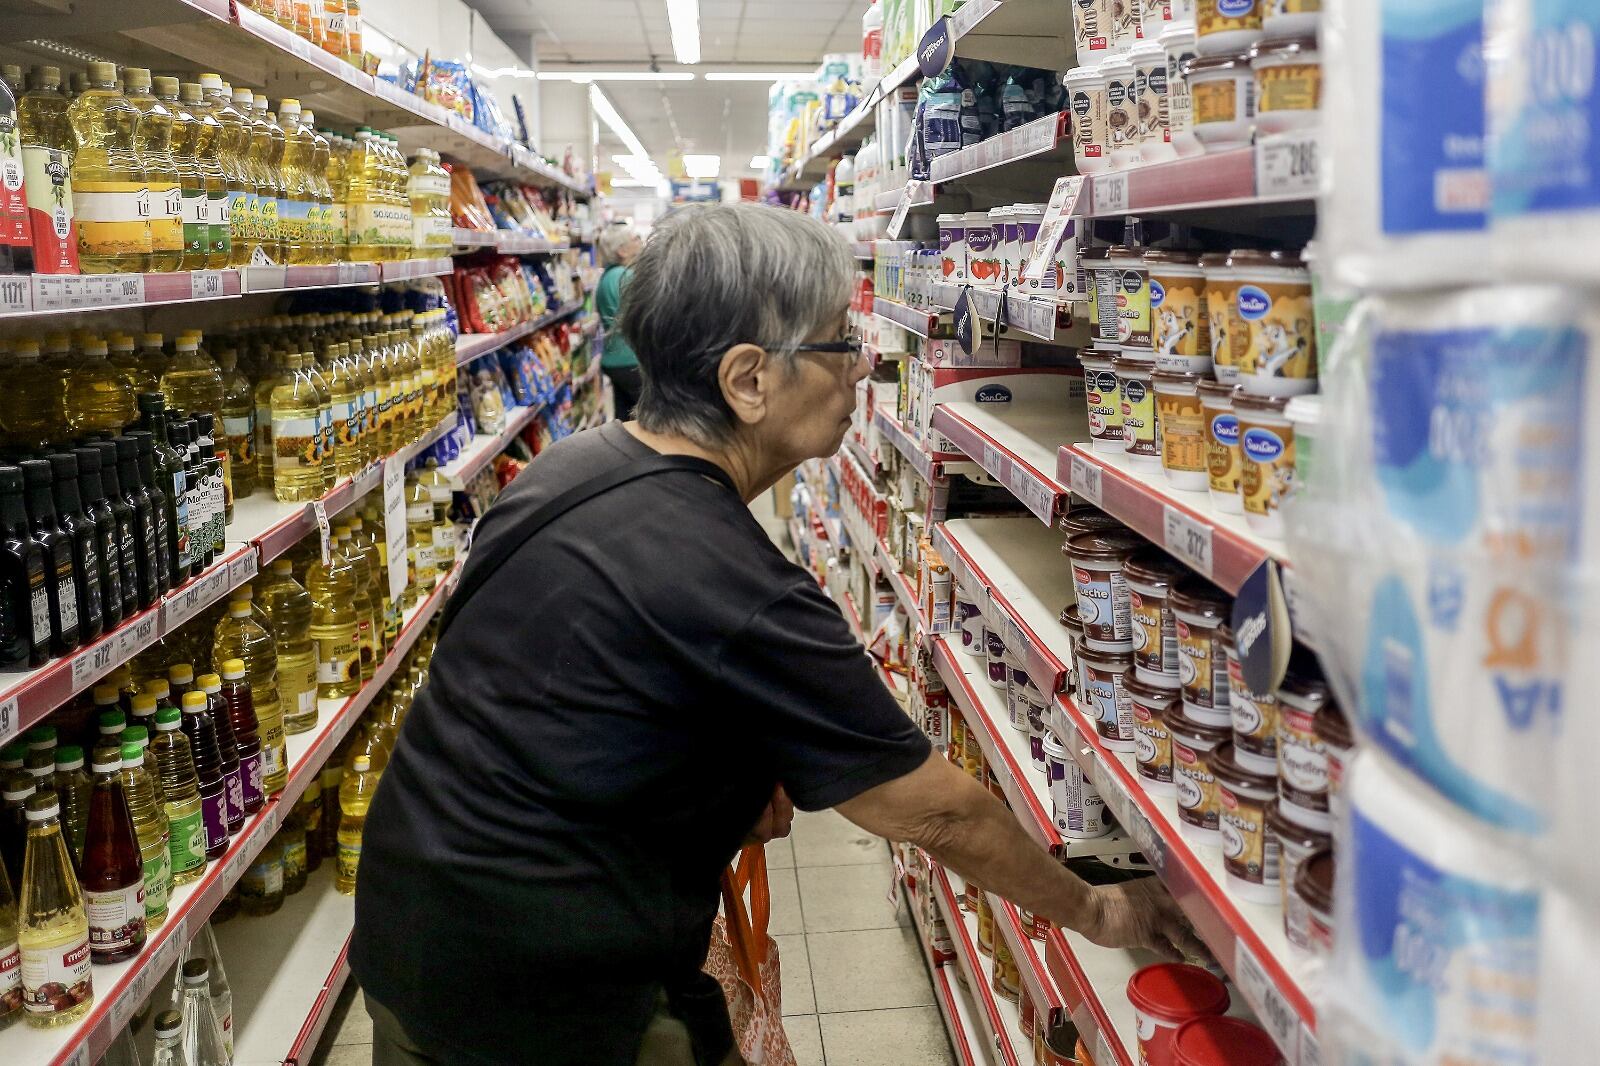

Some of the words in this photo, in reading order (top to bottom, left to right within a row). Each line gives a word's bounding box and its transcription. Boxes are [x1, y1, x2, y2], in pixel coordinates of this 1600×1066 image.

[968, 233, 991, 243] Emeth
[979, 392, 1009, 401] SanCor
[1246, 437, 1278, 453] SanCor
